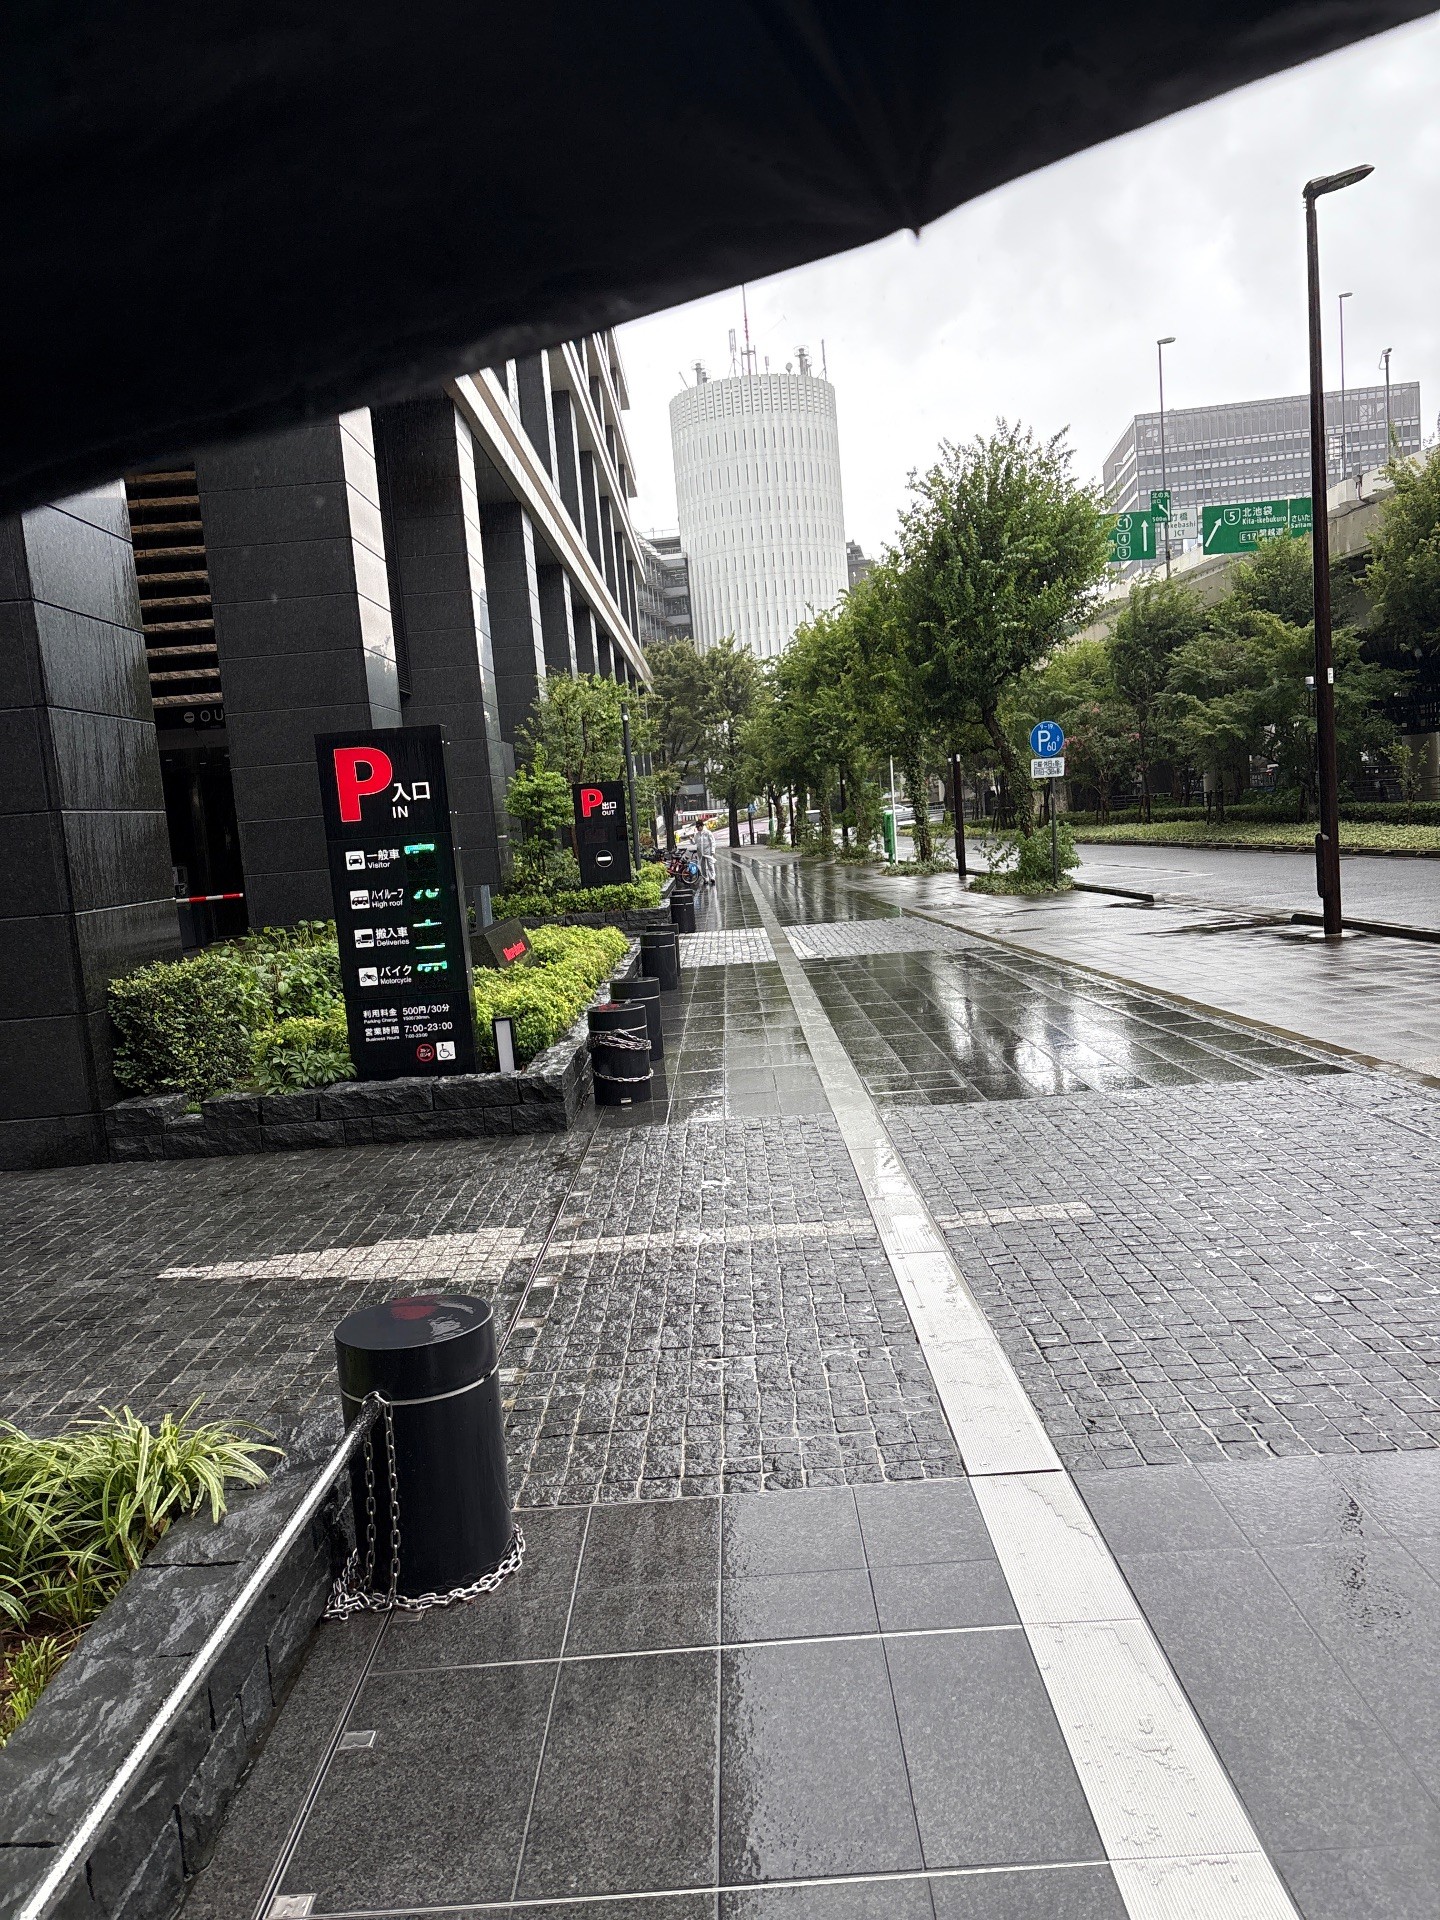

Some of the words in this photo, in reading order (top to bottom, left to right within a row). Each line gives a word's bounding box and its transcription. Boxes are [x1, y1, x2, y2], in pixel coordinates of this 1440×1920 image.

[1229, 512, 1236, 521] 5
[1242, 506, 1273, 517] 北池袋
[1117, 518, 1129, 528] C1
[1242, 516, 1286, 525] Kita-ikebukuro
[1291, 514, 1312, 522] さいた
[1120, 535, 1126, 543] 4
[1241, 532, 1256, 541] E17
[1122, 548, 1127, 556] 3
[200, 709, 224, 722] OU
[1038, 730, 1050, 752] P
[1047, 741, 1056, 751] 60
[334, 746, 393, 822] P
[392, 782, 430, 802] 入口
[581, 788, 603, 817] P
[602, 802, 616, 810] 出口
[392, 806, 408, 818] IN
[366, 849, 400, 861] 一般車
[372, 888, 404, 900] ハイルーフ
[372, 901, 388, 909] High
[376, 927, 408, 939] 搬入車
[377, 938, 410, 946] Deliveries
[380, 965, 412, 977] バイク
[380, 976, 412, 985] Motorcycle
[363, 1008, 397, 1018] 利用料金
[402, 1004, 450, 1015] 500円/30分
[364, 1026, 400, 1036] 営業時間
[404, 1022, 453, 1033] 7:00-23:00
